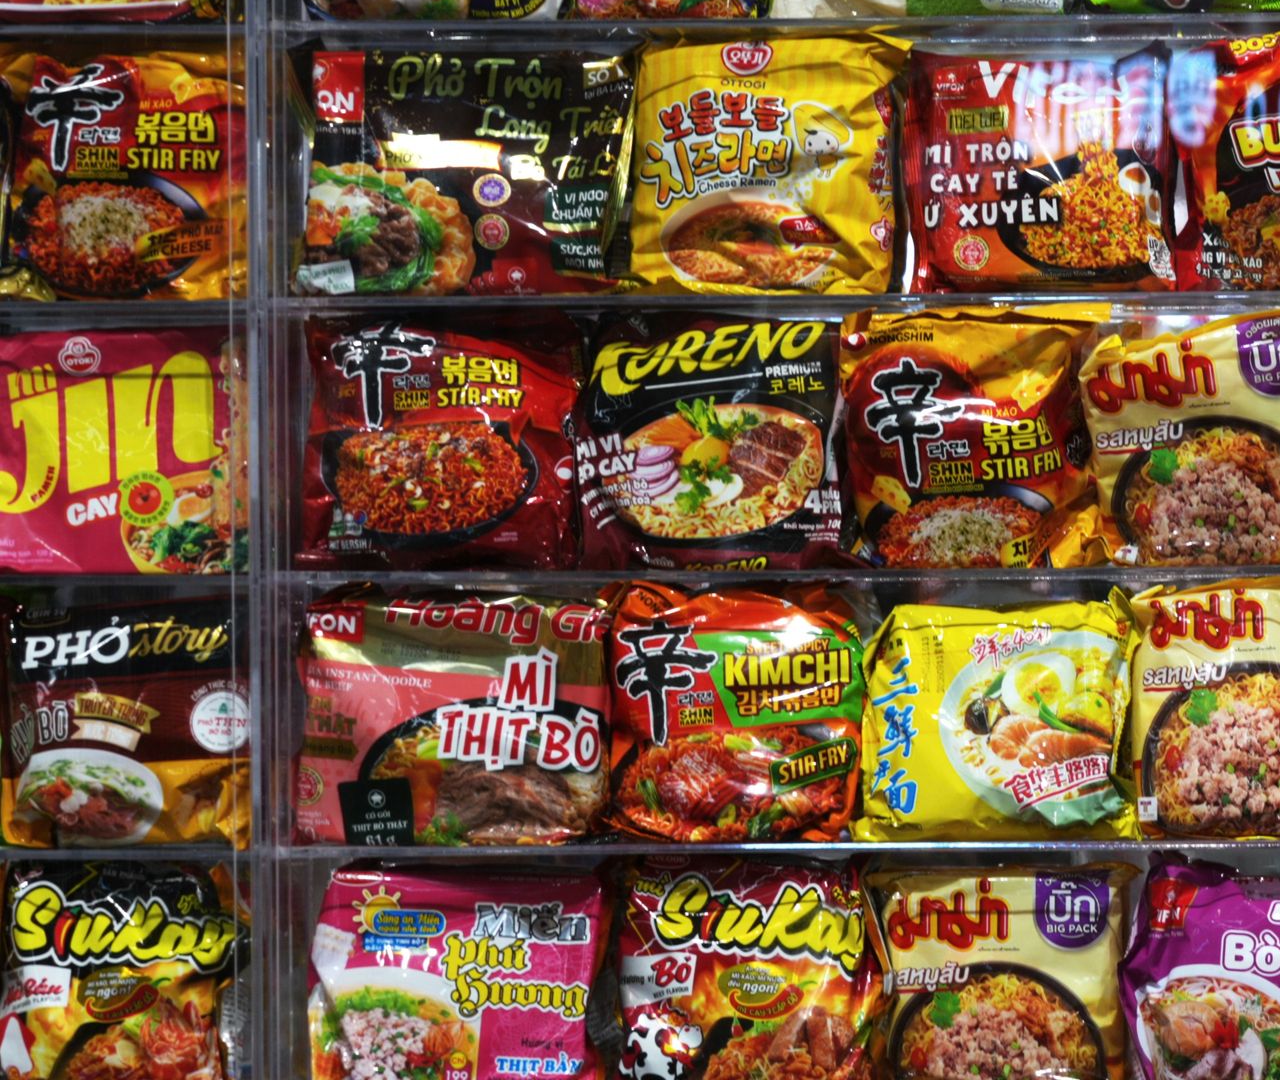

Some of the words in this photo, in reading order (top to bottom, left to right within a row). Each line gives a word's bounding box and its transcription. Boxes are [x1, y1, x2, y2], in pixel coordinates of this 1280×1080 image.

[720, 78, 765, 89] OTTOGI
[77, 149, 118, 160] SHIN
[128, 149, 174, 169] STIR
[180, 151, 219, 171] FRY
[699, 179, 733, 193] Cheese
[737, 177, 776, 188] Ramen
[930, 172, 982, 194] CAY
[991, 170, 1017, 191] TÊ
[868, 330, 934, 344] NONGSHIM
[23, 617, 129, 668] PHỞ
[724, 651, 848, 686] KIMCHI
[381, 676, 430, 688] NOODLE
[503, 649, 555, 708] MÌ
[680, 708, 713, 719] SHIN
[779, 756, 815, 784] STIR
[818, 744, 847, 771] FRY
